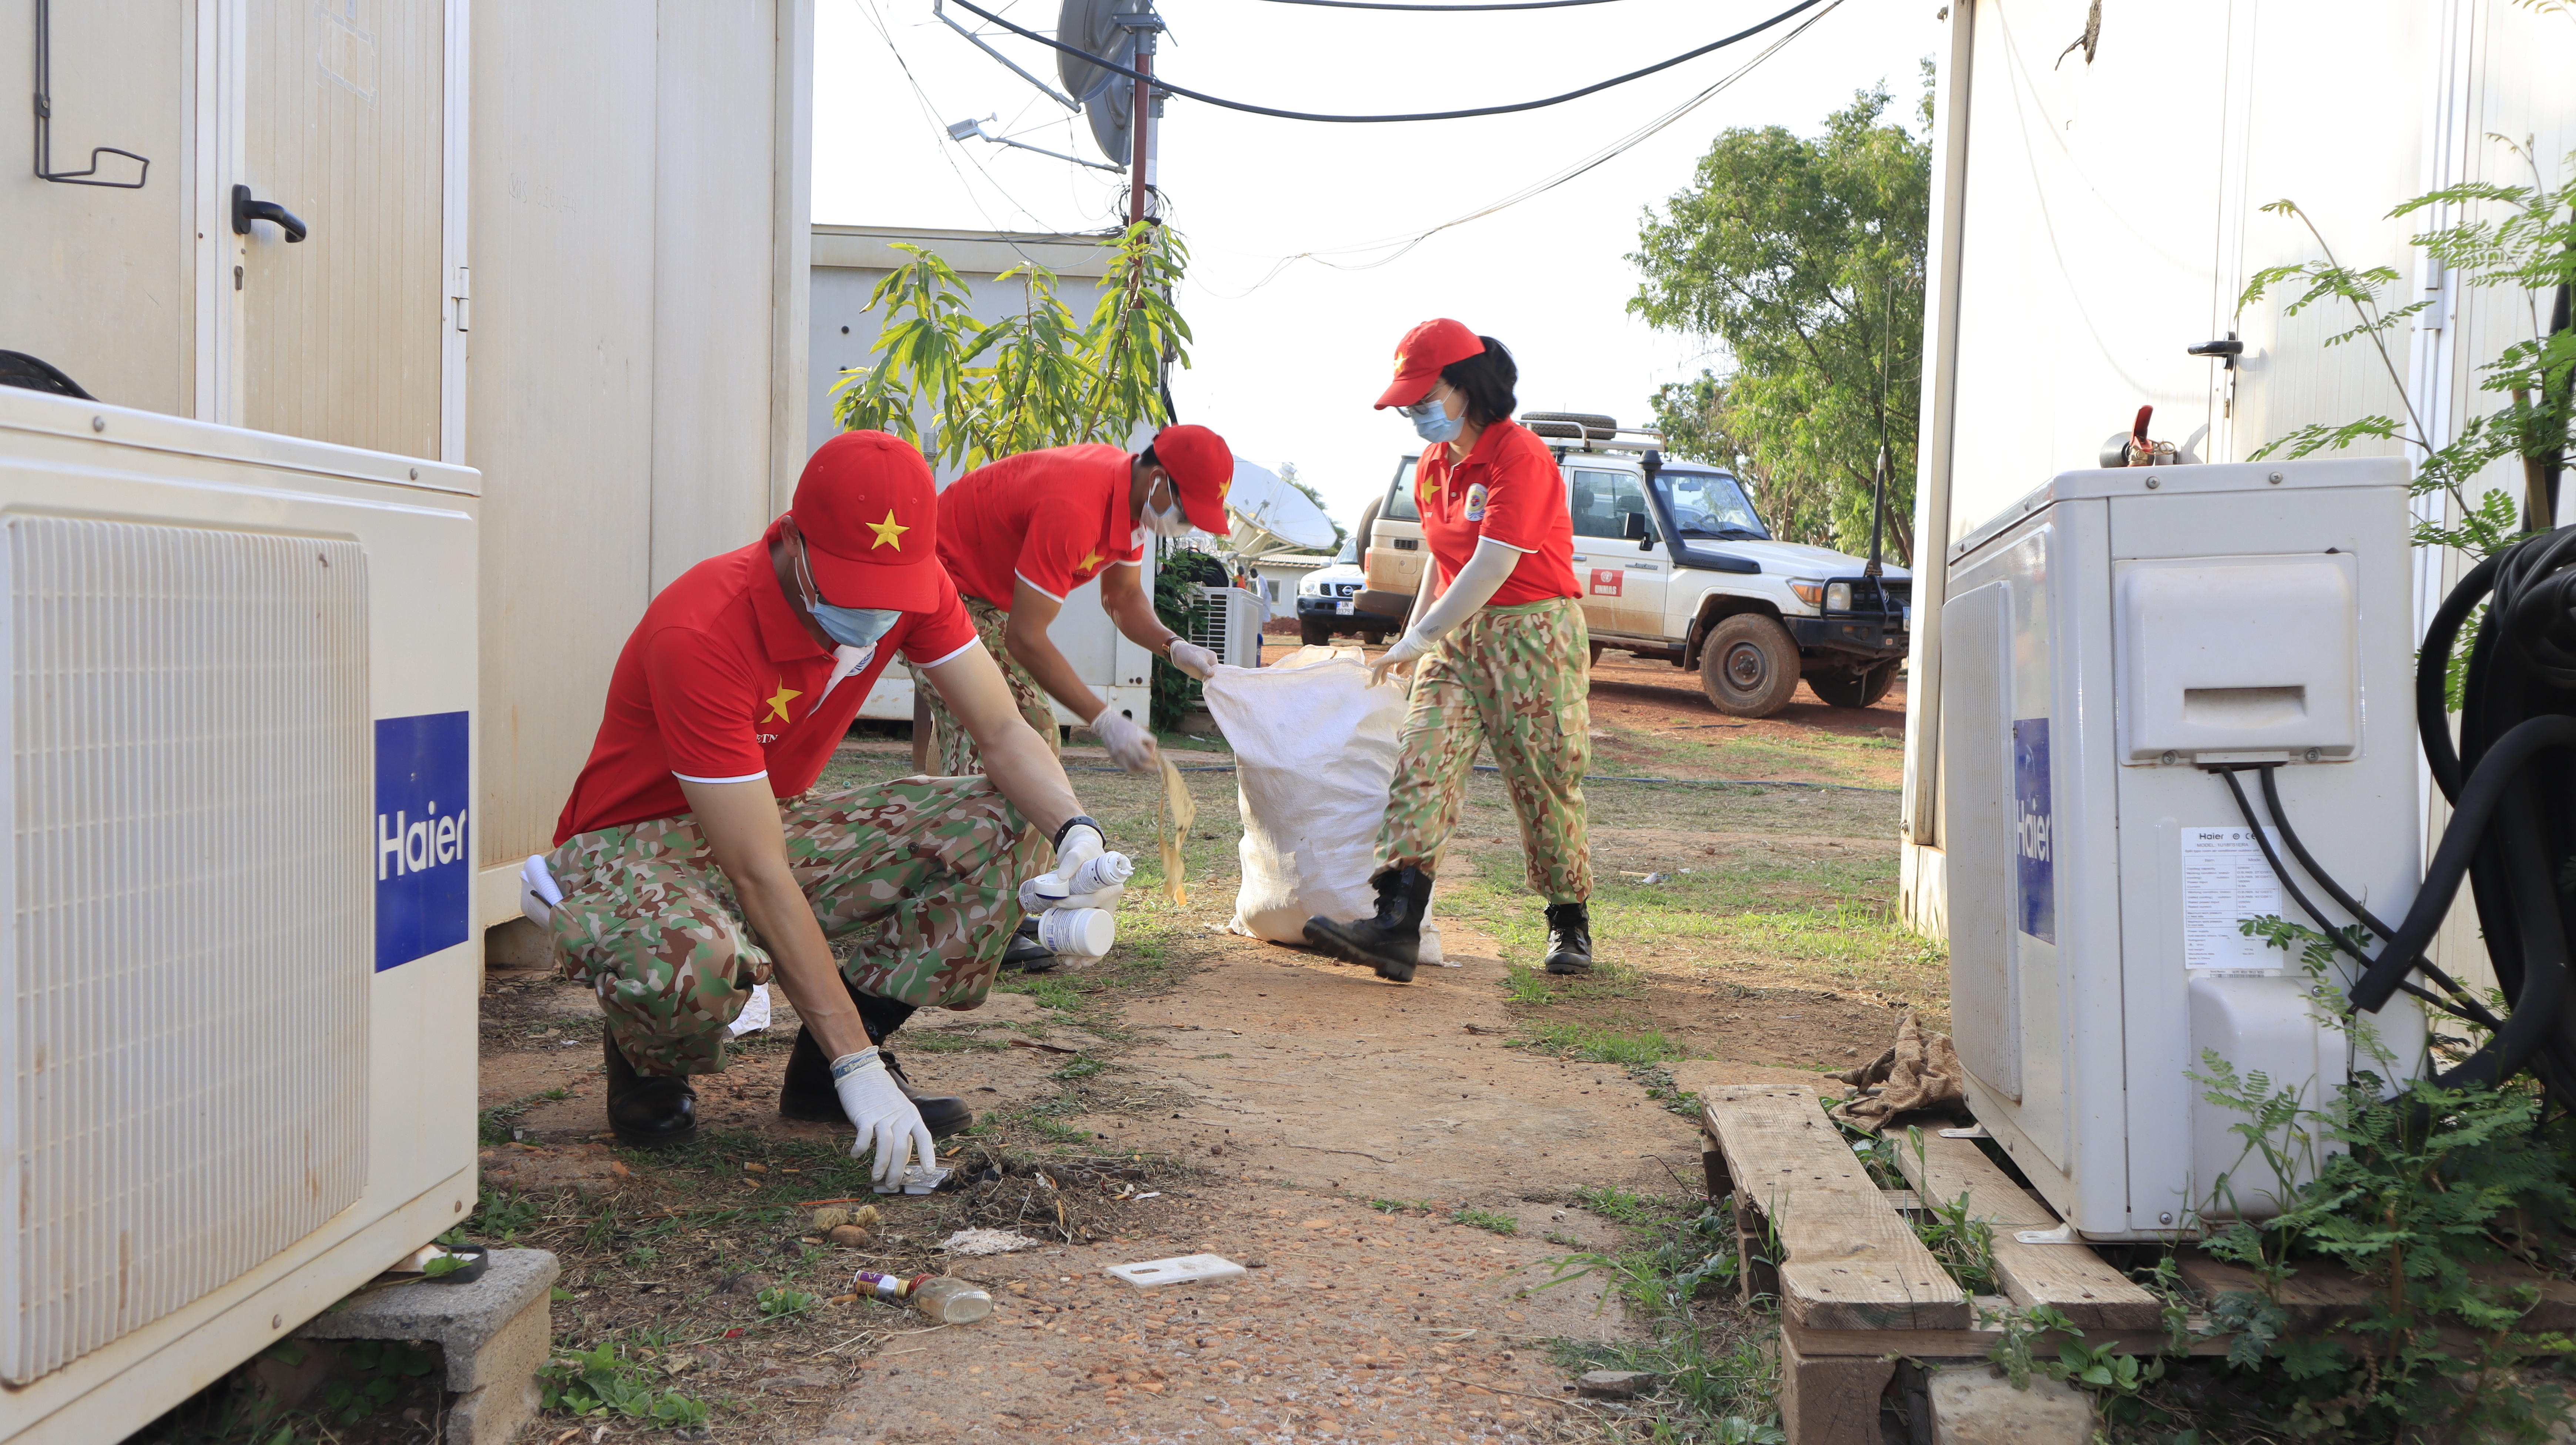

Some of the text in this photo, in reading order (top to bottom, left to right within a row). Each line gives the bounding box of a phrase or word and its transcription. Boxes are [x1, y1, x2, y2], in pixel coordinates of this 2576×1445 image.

[1594, 584, 1617, 595] UNMAS
[756, 734, 779, 743] ETN
[378, 801, 466, 881] Haier
[2016, 798, 2050, 862] Haier
